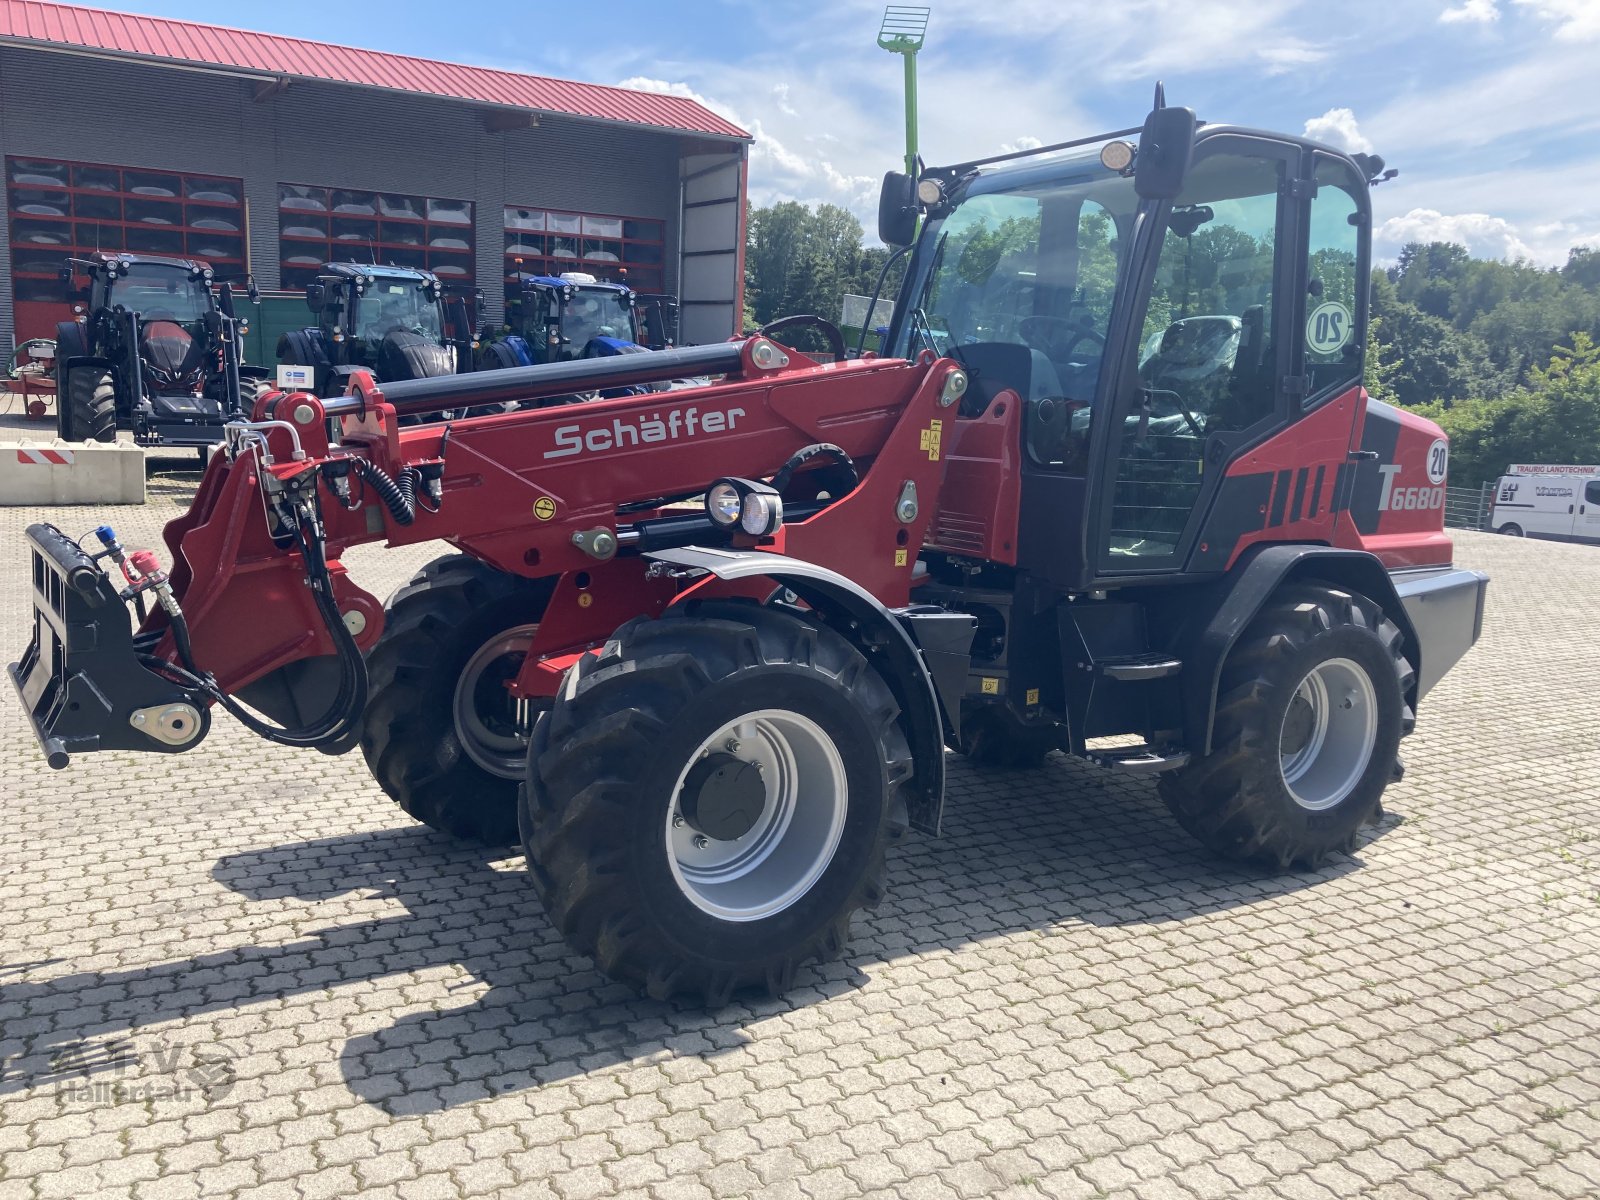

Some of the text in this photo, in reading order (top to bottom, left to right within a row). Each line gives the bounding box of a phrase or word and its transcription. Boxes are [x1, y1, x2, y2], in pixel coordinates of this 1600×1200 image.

[543, 407, 746, 459] Schäffer
[1431, 447, 1446, 476] 20
[1516, 465, 1596, 474] TRAURIG LANDTECHNIK
